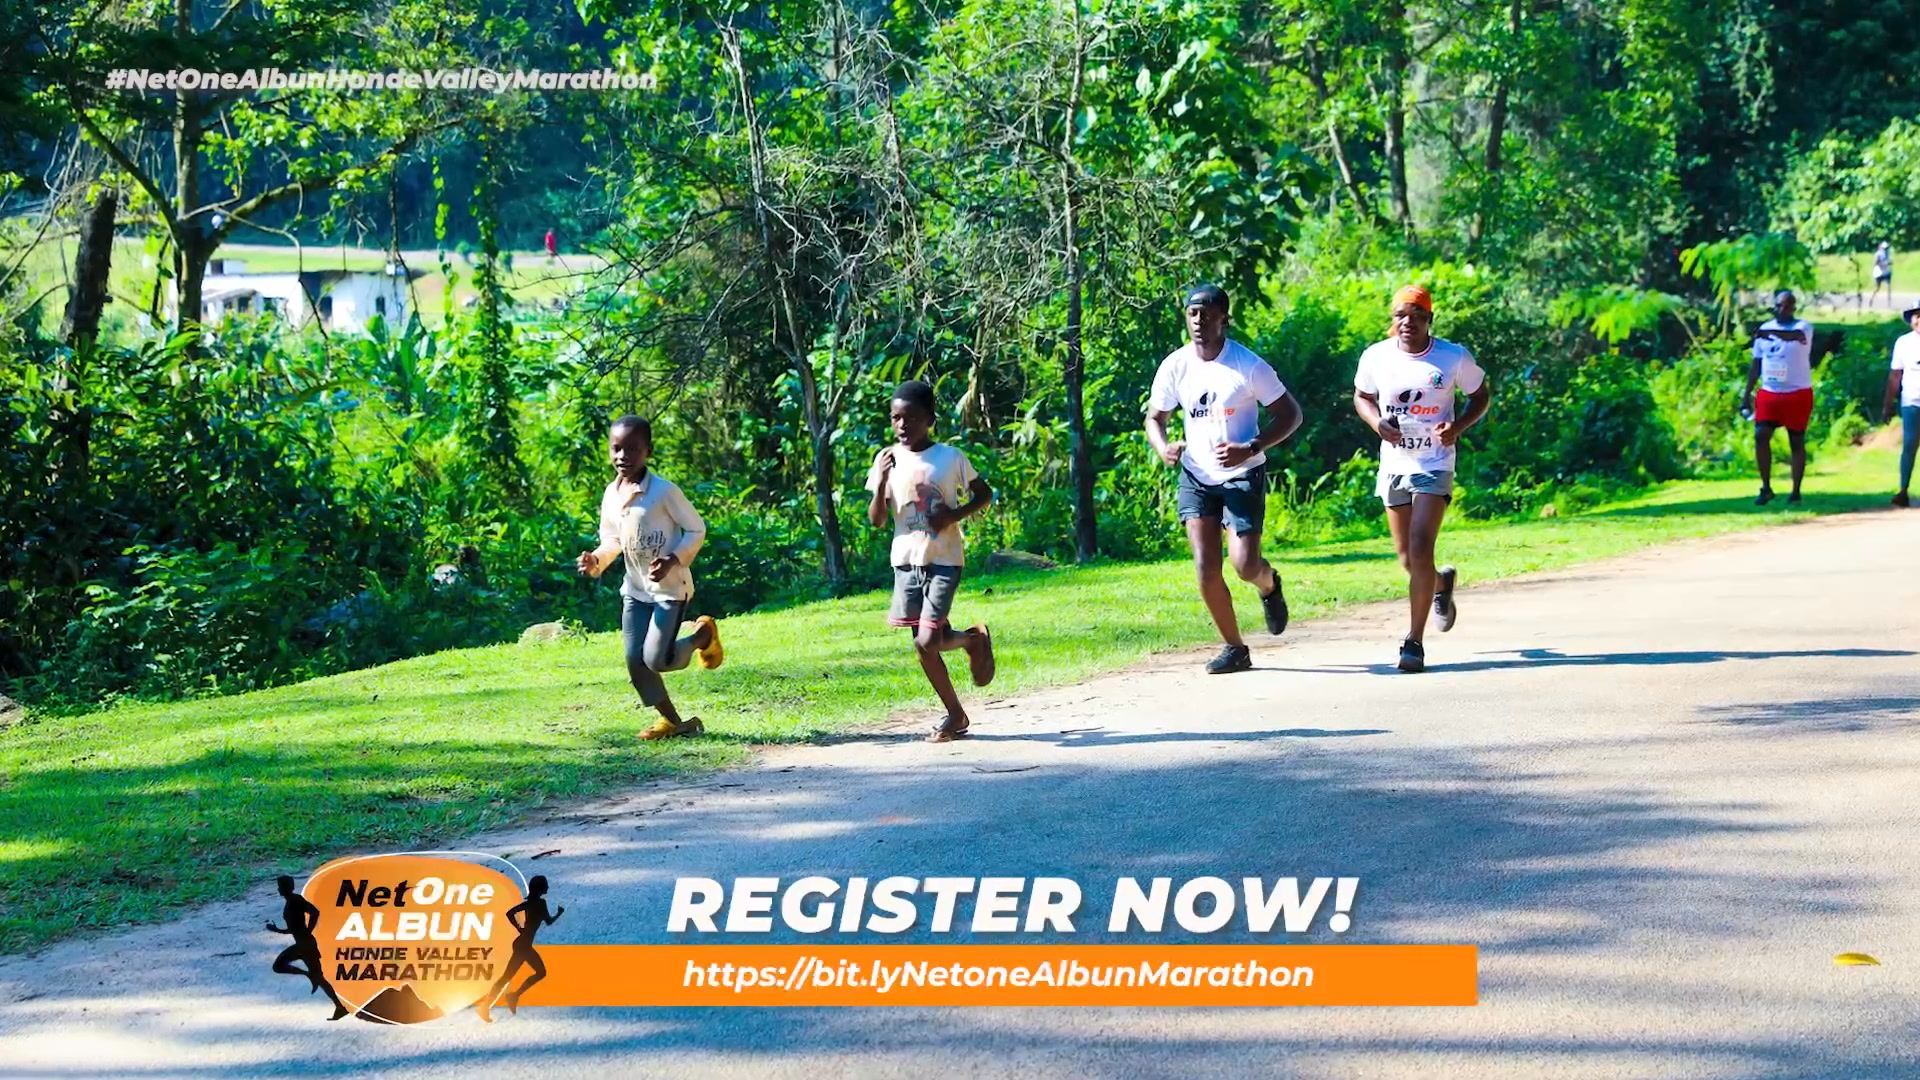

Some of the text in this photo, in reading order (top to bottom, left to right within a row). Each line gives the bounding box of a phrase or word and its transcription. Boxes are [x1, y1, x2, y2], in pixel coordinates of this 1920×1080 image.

[1189, 407, 1236, 419] Netne
[1386, 404, 1440, 416] NetOne
[1398, 436, 1433, 450] 4374
